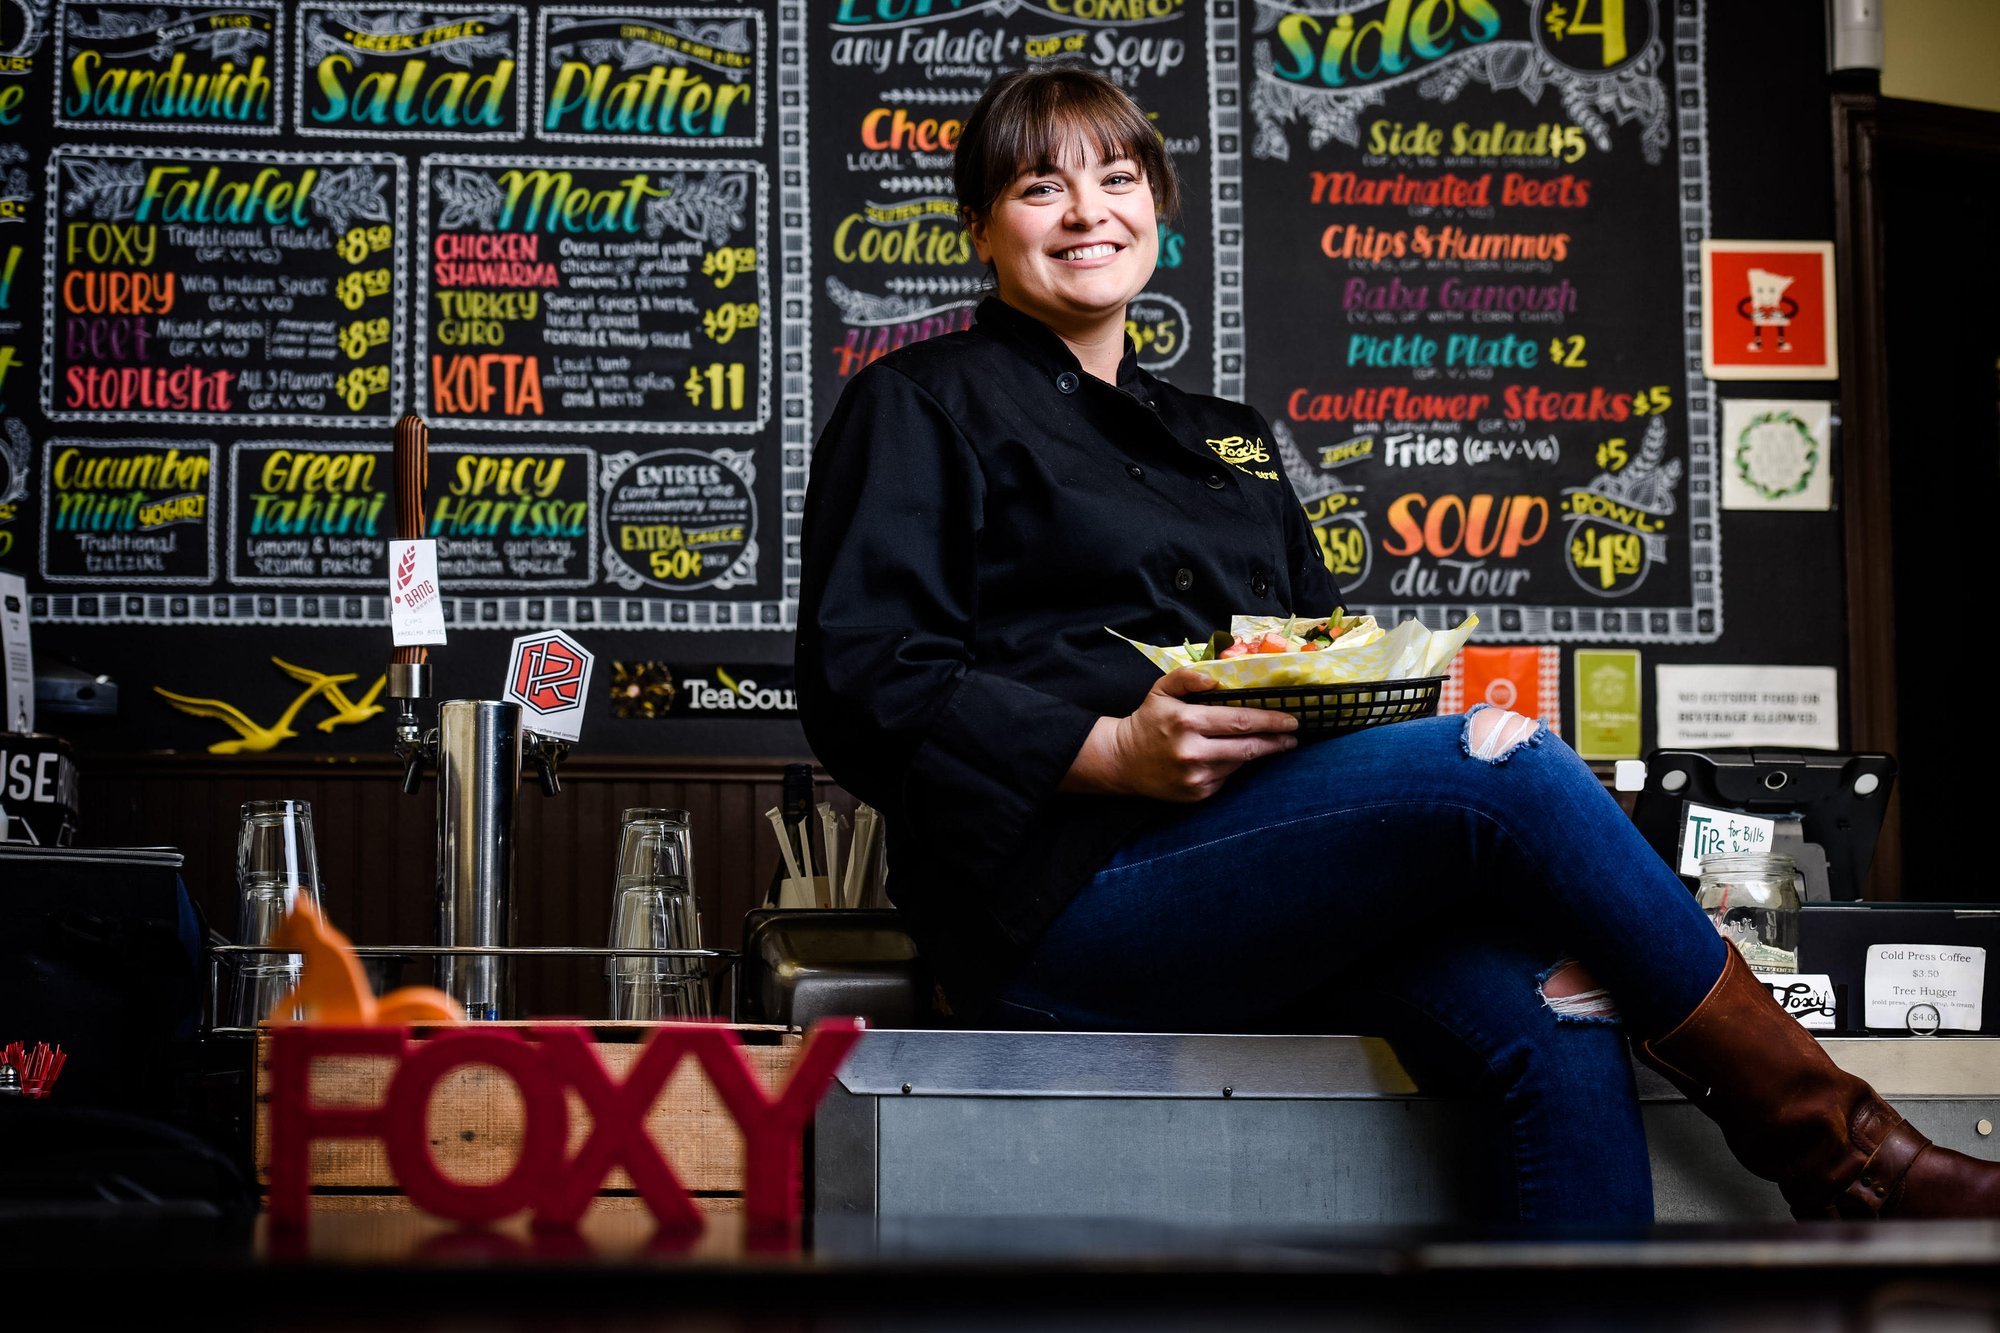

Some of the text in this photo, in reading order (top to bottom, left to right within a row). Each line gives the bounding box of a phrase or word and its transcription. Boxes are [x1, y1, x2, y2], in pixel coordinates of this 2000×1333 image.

[831, 37, 893, 74] any
[897, 28, 1002, 65] Falafel
[1025, 37, 1061, 57] CUP
[1090, 28, 1185, 76] Soup
[1274, 0, 1500, 86] Sides
[65, 50, 271, 121] Sandwich
[311, 54, 515, 127] Salad
[545, 60, 751, 135] Platter
[861, 108, 962, 151] Chee
[1367, 120, 1587, 163] Side Salad $5
[846, 152, 905, 171] LOCAL
[135, 167, 317, 226] Falafel
[497, 170, 672, 233] Meat
[1309, 170, 1591, 207] Marinated Beets
[67, 223, 156, 266] FOXY
[164, 225, 262, 247] Traditional
[270, 227, 333, 249] Falafel
[435, 233, 538, 260] CHICKEN
[833, 213, 971, 266] Cookies
[1321, 224, 1407, 262] Chips
[1433, 226, 1571, 262] Hummus
[63, 271, 175, 314] CURRY
[435, 262, 560, 288] SHAWARMA
[1342, 277, 1579, 313] Baba Ganoush
[435, 291, 538, 320] TURKEY
[437, 321, 504, 346] GYRO
[1347, 333, 1588, 368] Pickle Plate $2
[432, 354, 544, 415] KOFTA
[684, 363, 745, 411] $11
[1287, 385, 1672, 422] Cauliflower Steaks $5
[54, 448, 210, 490] Cucumber
[261, 449, 376, 493] Green
[1384, 434, 1458, 467] Fries
[1596, 438, 1628, 471] $5
[636, 464, 722, 486] ENTREES
[250, 492, 387, 537] Tahini
[430, 496, 588, 537] Harissa
[1304, 494, 1348, 521] UP
[1383, 492, 1549, 559] SOUP
[1572, 493, 1655, 533] BOWL
[76, 532, 177, 552] Traditional
[620, 526, 684, 551] EXTRA
[405, 579, 435, 608] BANG
[1390, 557, 1440, 597] du
[0, 752, 58, 803] SE
[1690, 815, 1764, 859] Tips for Bills
[1880, 951, 1972, 963] Cold Press Coffee
[1912, 969, 1939, 978] $3.50
[1773, 983, 1836, 1015] Foxy
[1893, 986, 1957, 999] Tree Hugger
[1912, 1013, 1939, 1022] $4.00
[268, 1017, 862, 1232] FOXY
